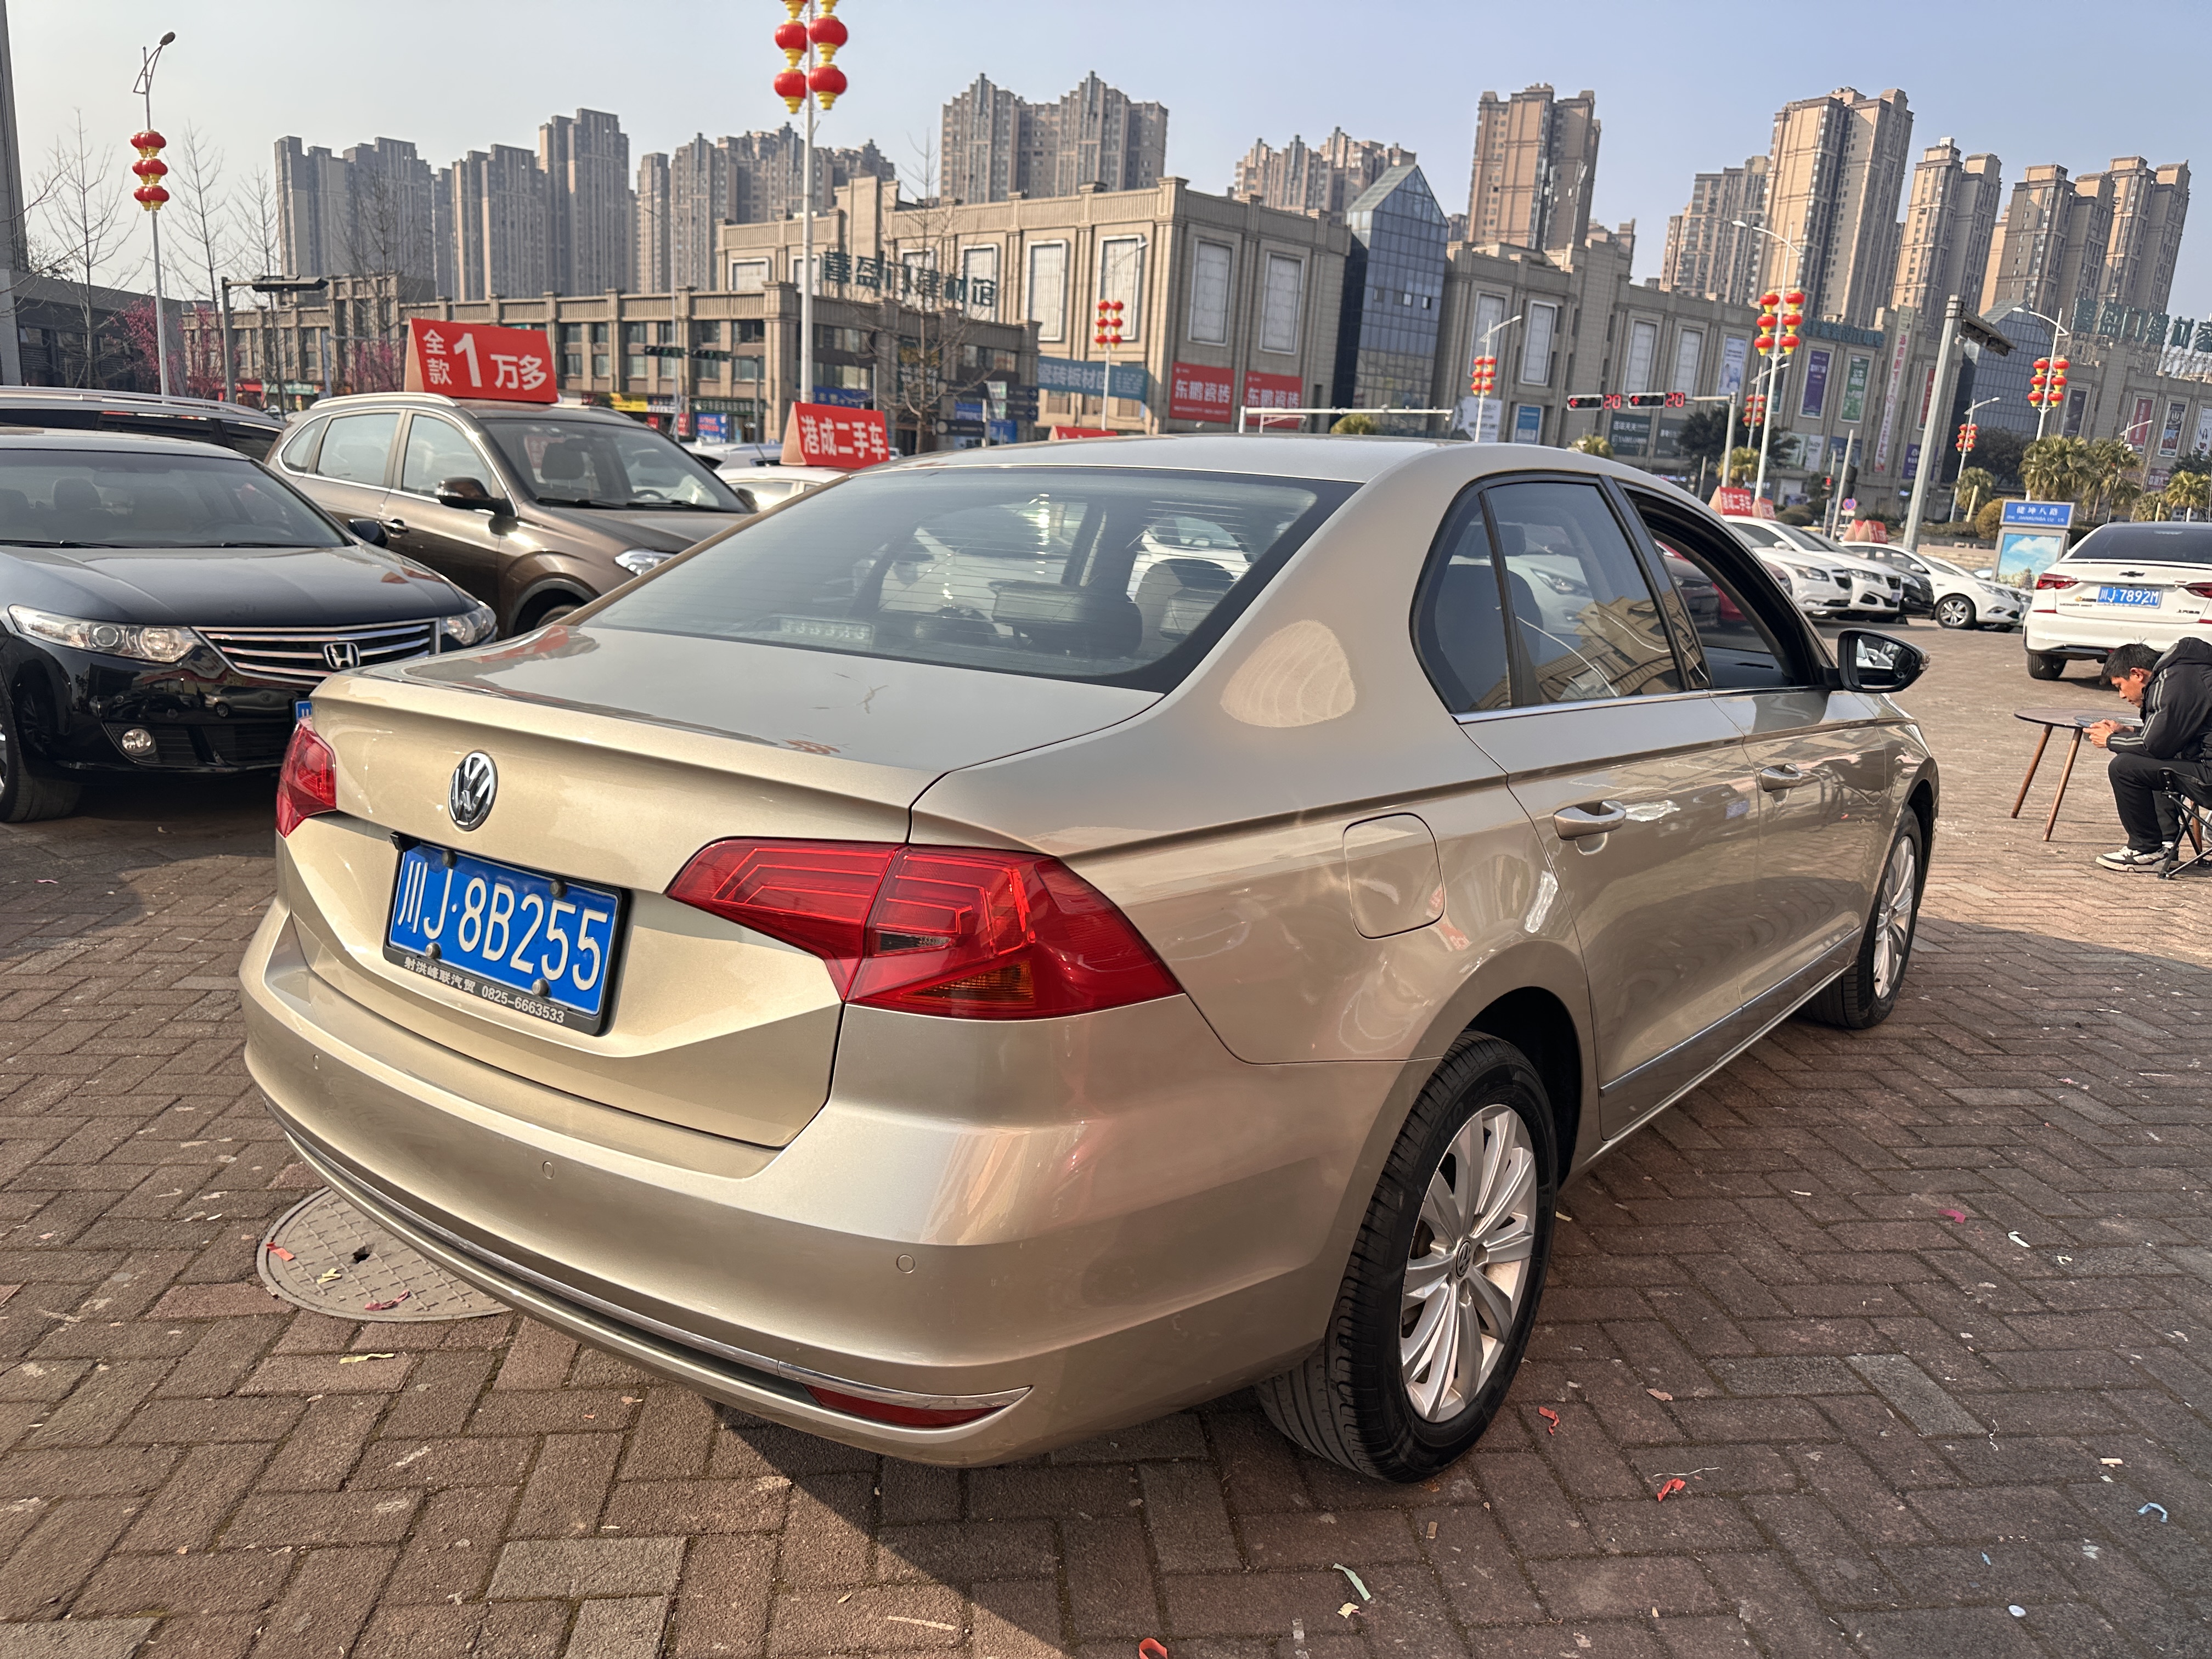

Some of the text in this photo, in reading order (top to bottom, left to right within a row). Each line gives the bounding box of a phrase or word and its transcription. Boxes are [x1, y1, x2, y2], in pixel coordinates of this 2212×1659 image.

[422, 329, 452, 385] 全款
[1175, 379, 1232, 404] 东鹏瓷砖
[1247, 387, 1299, 408] 东鹏瓷砖
[1604, 394, 1622, 409] 20
[1665, 392, 1685, 408] 20
[800, 415, 886, 461] 港成二手车
[404, 956, 565, 1024] 射洪峰联汽贸 0825-6663533
